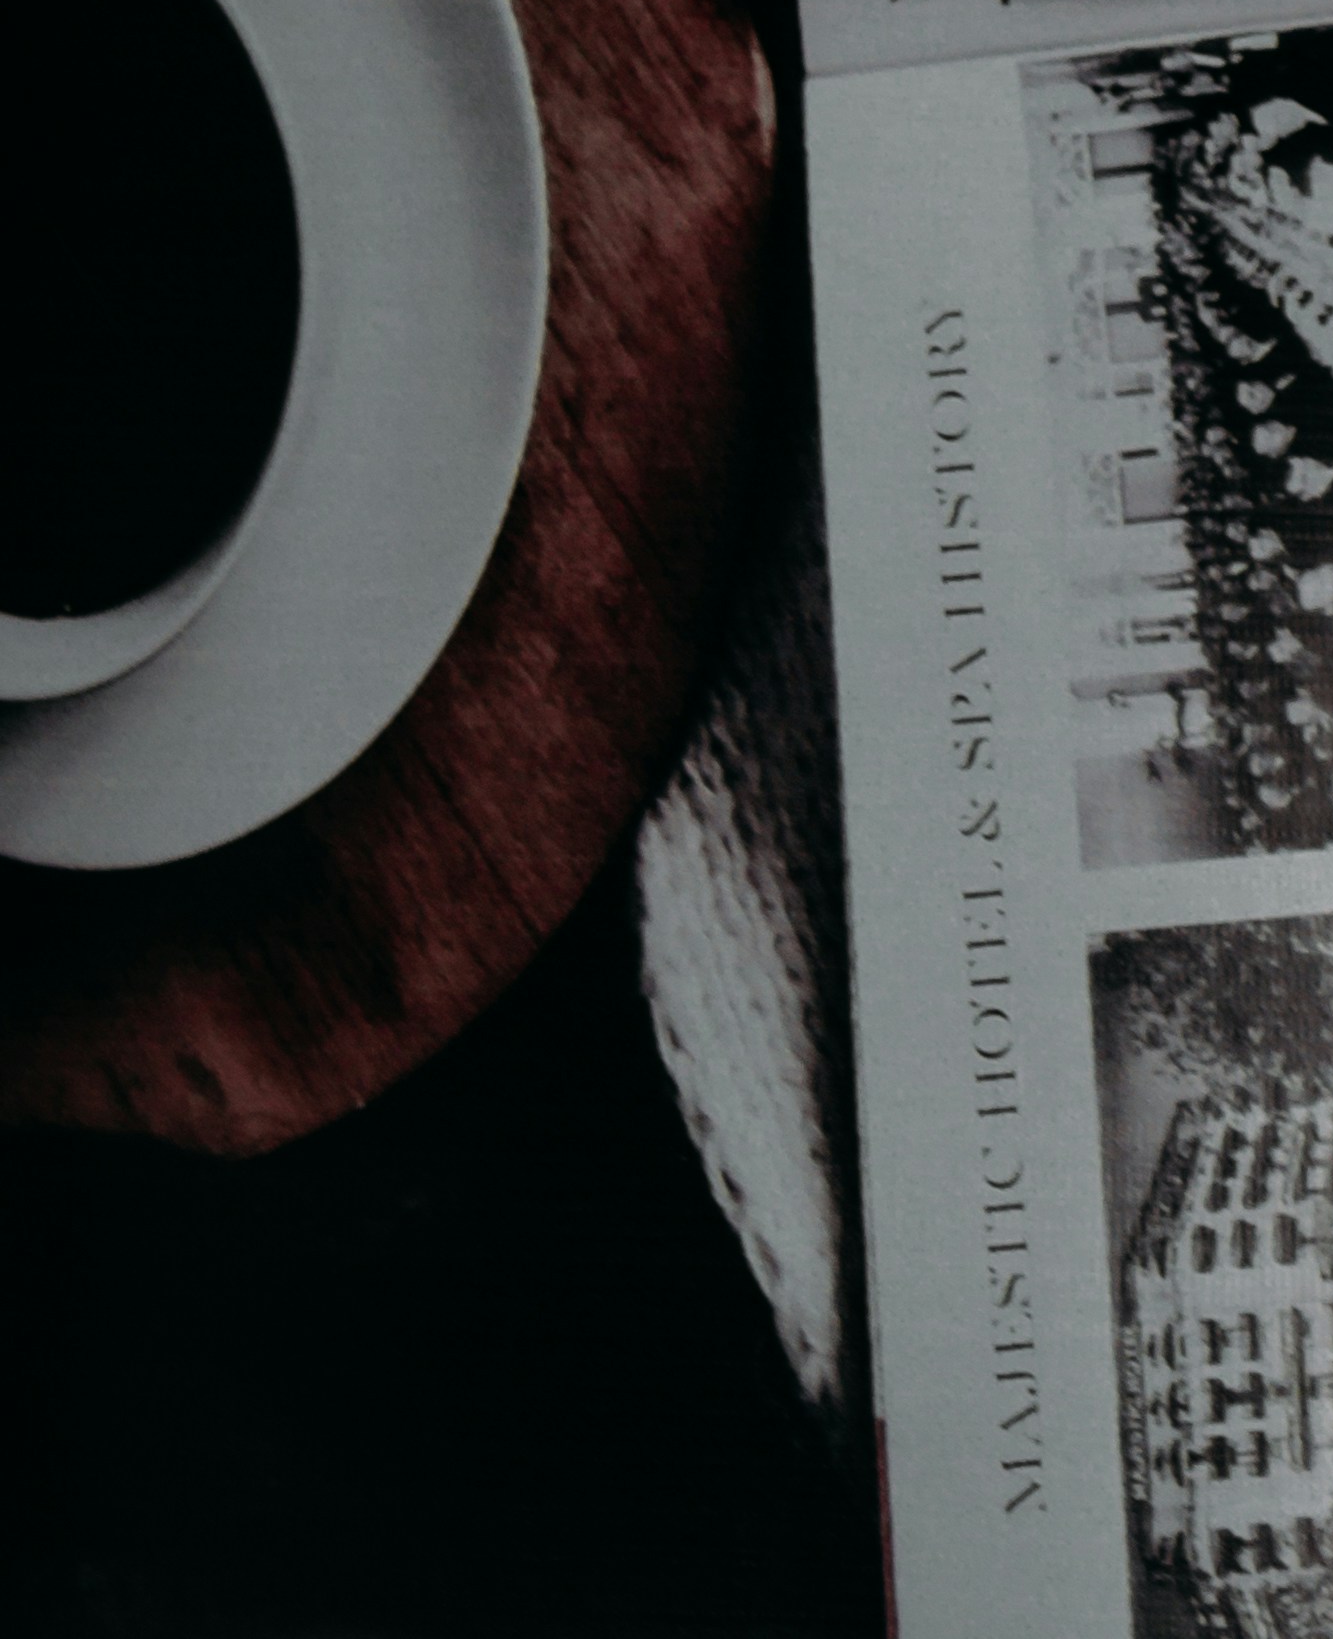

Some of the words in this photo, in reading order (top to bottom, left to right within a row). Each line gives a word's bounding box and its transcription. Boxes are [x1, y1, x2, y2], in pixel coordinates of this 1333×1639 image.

[922, 298, 986, 621] HISTORY
[945, 645, 994, 772] SPA
[954, 797, 1001, 843] &
[961, 857, 1020, 1118] HOTEL
[982, 1142, 1049, 1513] MAJESTIC
